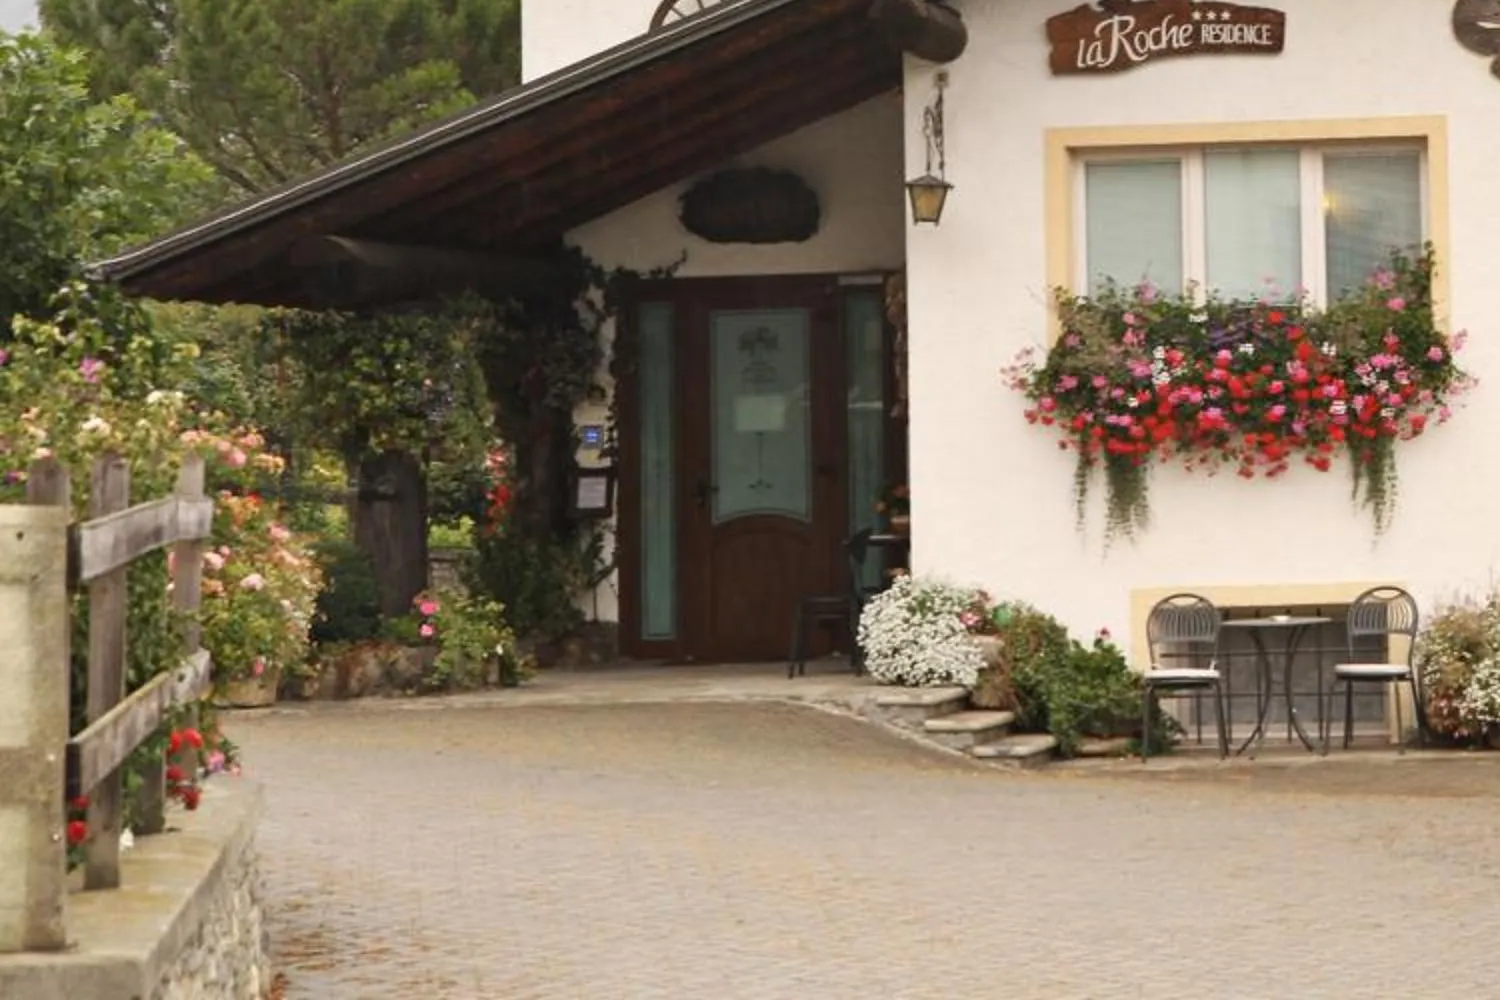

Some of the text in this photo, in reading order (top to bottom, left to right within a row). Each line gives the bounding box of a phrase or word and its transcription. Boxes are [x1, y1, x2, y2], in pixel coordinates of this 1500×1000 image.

[1076, 14, 1273, 68] la Roche RESIDENCE
